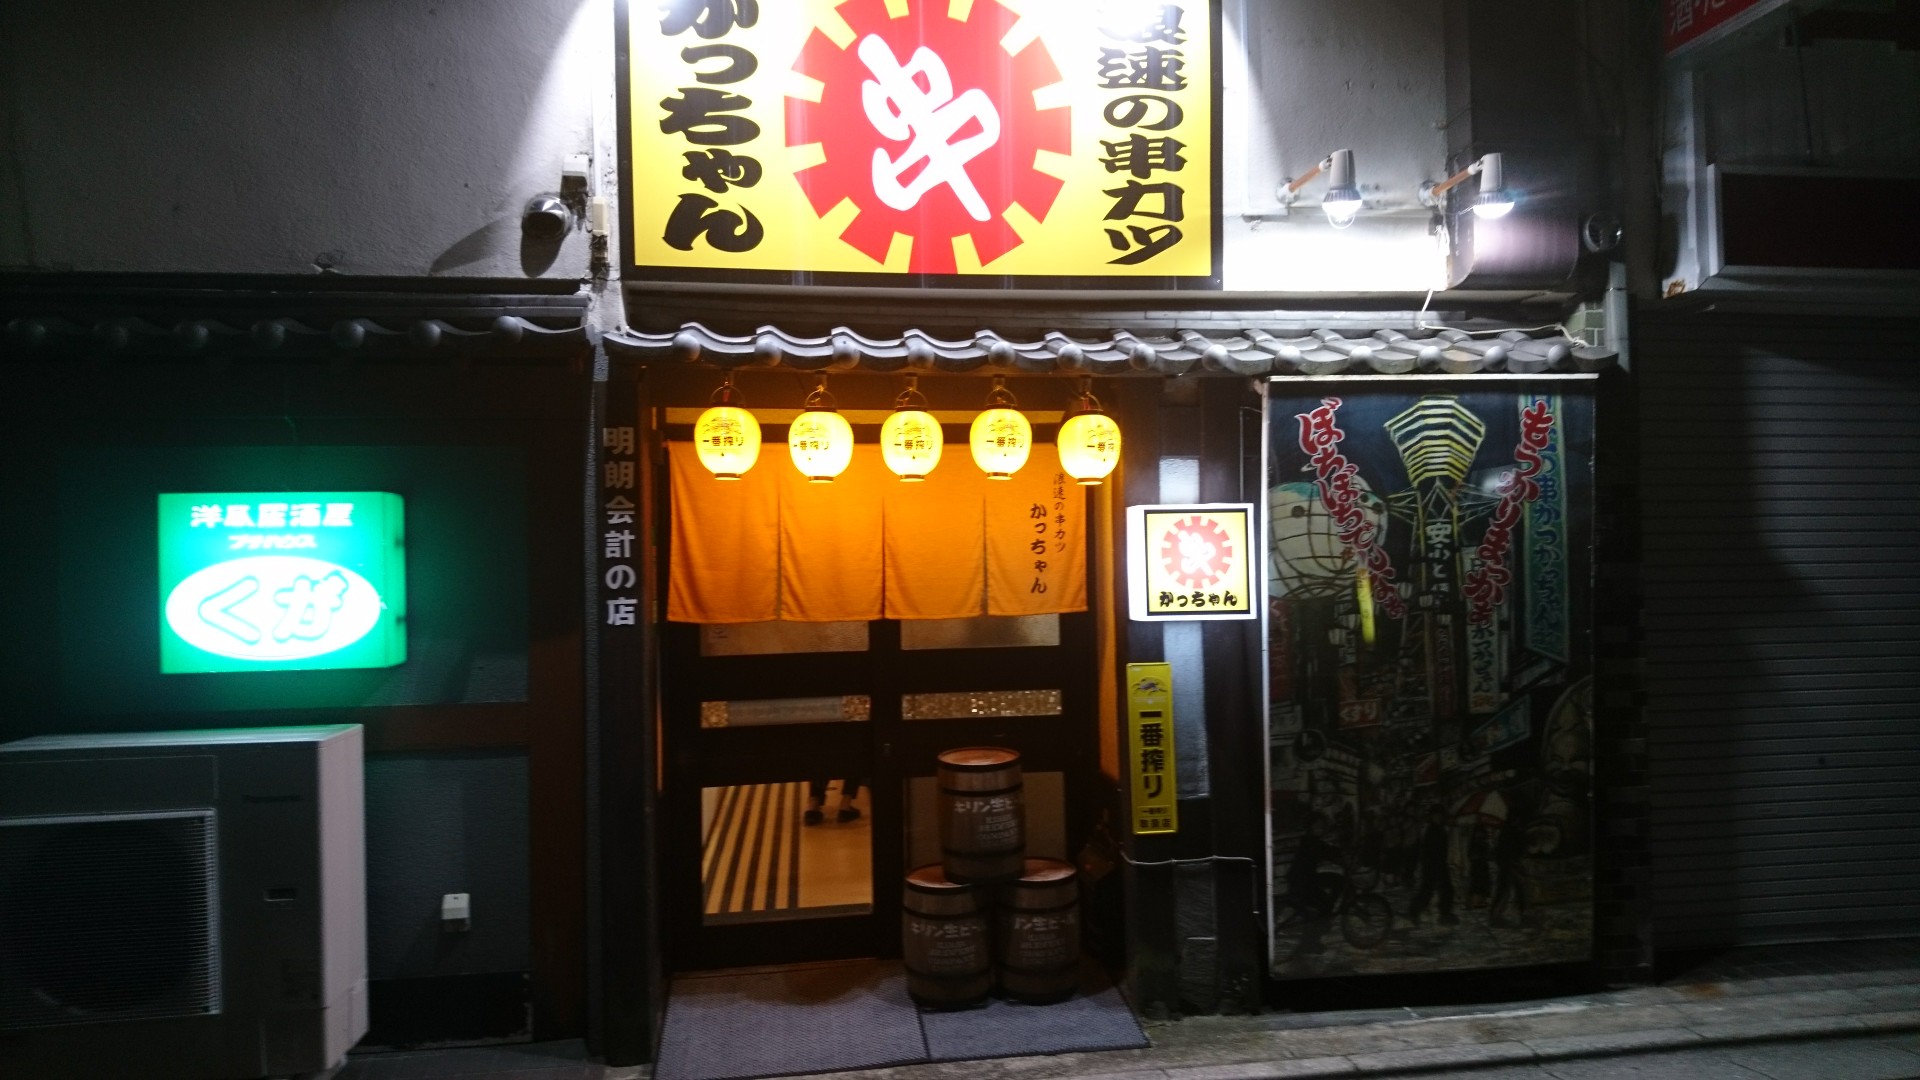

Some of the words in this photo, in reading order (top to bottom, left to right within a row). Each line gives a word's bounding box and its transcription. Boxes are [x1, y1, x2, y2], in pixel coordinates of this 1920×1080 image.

[603, 426, 638, 626] 明朗会計の店
[1030, 503, 1047, 594] かっちゃん
[1053, 473, 1066, 553] 浪速の串カツ
[1159, 591, 1238, 608] かっちゃん
[1140, 710, 1165, 799] 一番搾り
